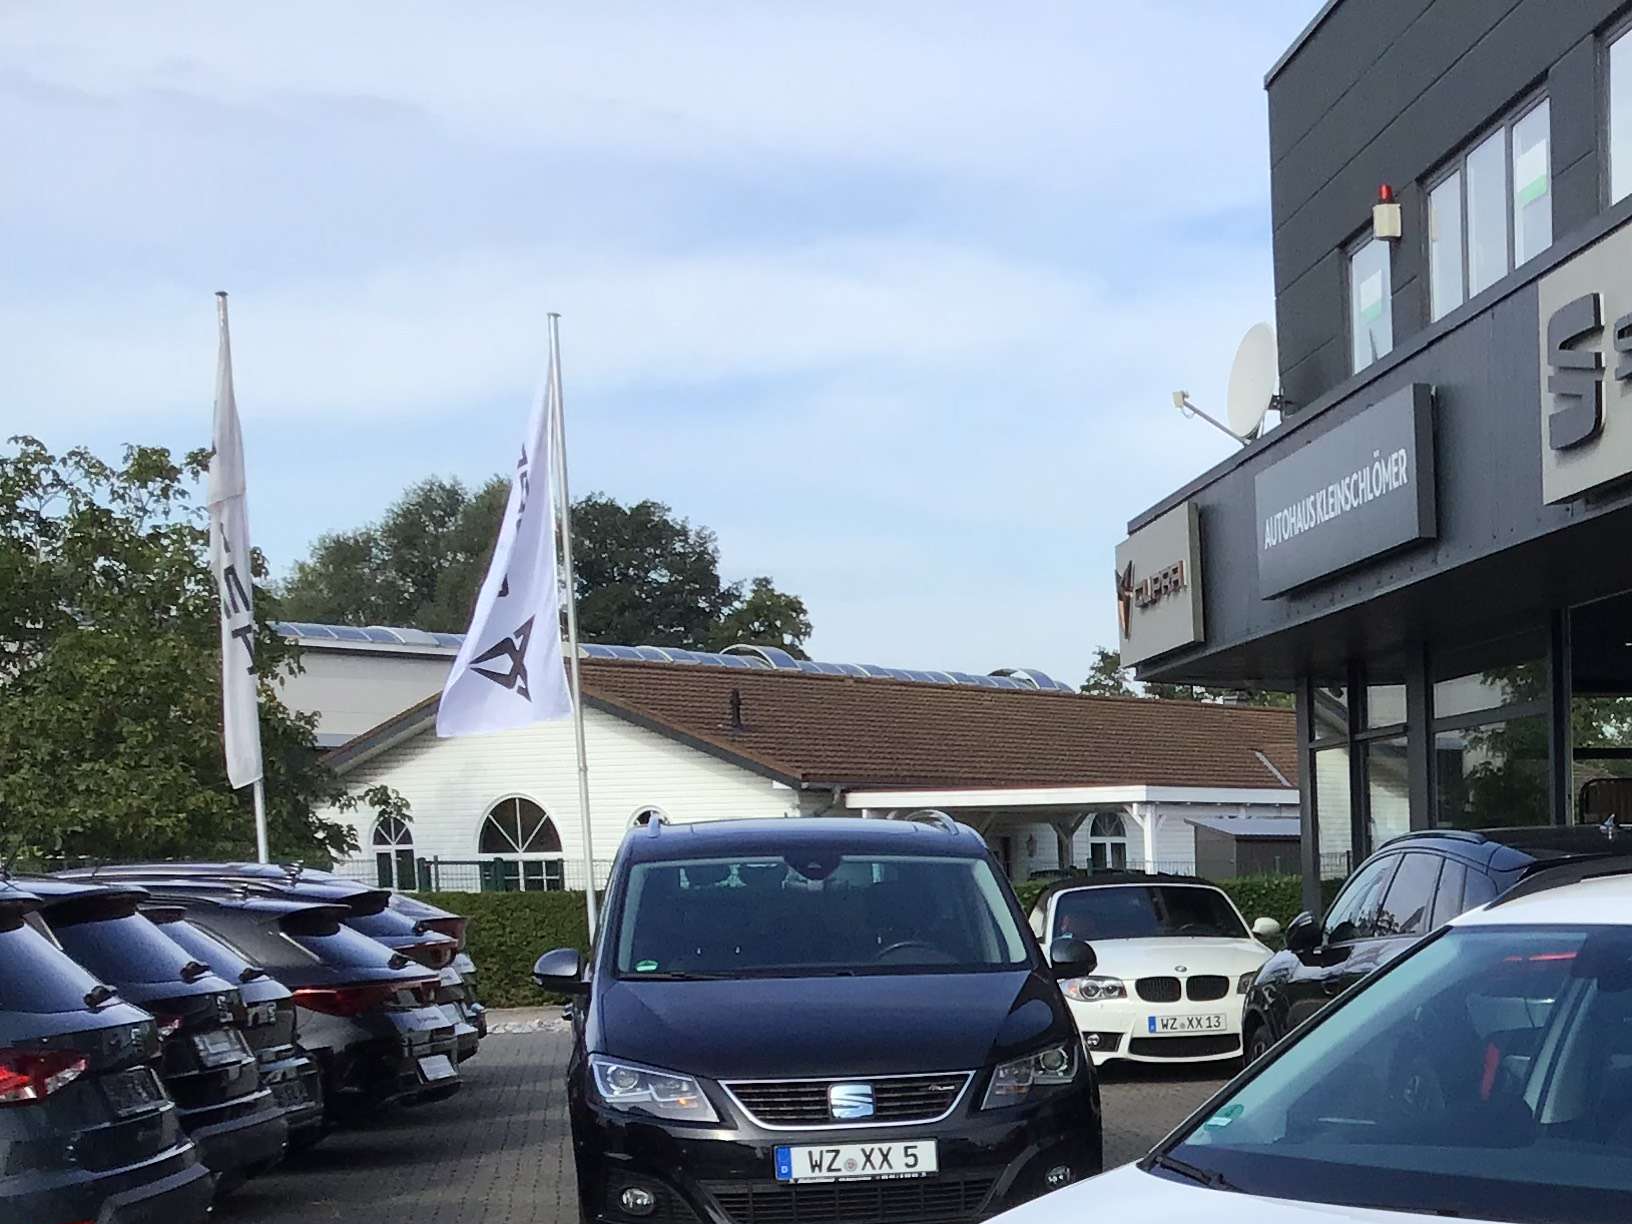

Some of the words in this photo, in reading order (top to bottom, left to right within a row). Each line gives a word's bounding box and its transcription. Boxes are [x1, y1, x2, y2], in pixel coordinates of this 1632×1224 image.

[1134, 560, 1184, 608] CUPRA
[1161, 1017, 1178, 1030] WZ
[1187, 1016, 1203, 1029] XX
[1205, 1015, 1221, 1029] 13
[807, 1149, 842, 1174] WZ
[861, 1147, 893, 1171] XX
[903, 1145, 919, 1169] 5
